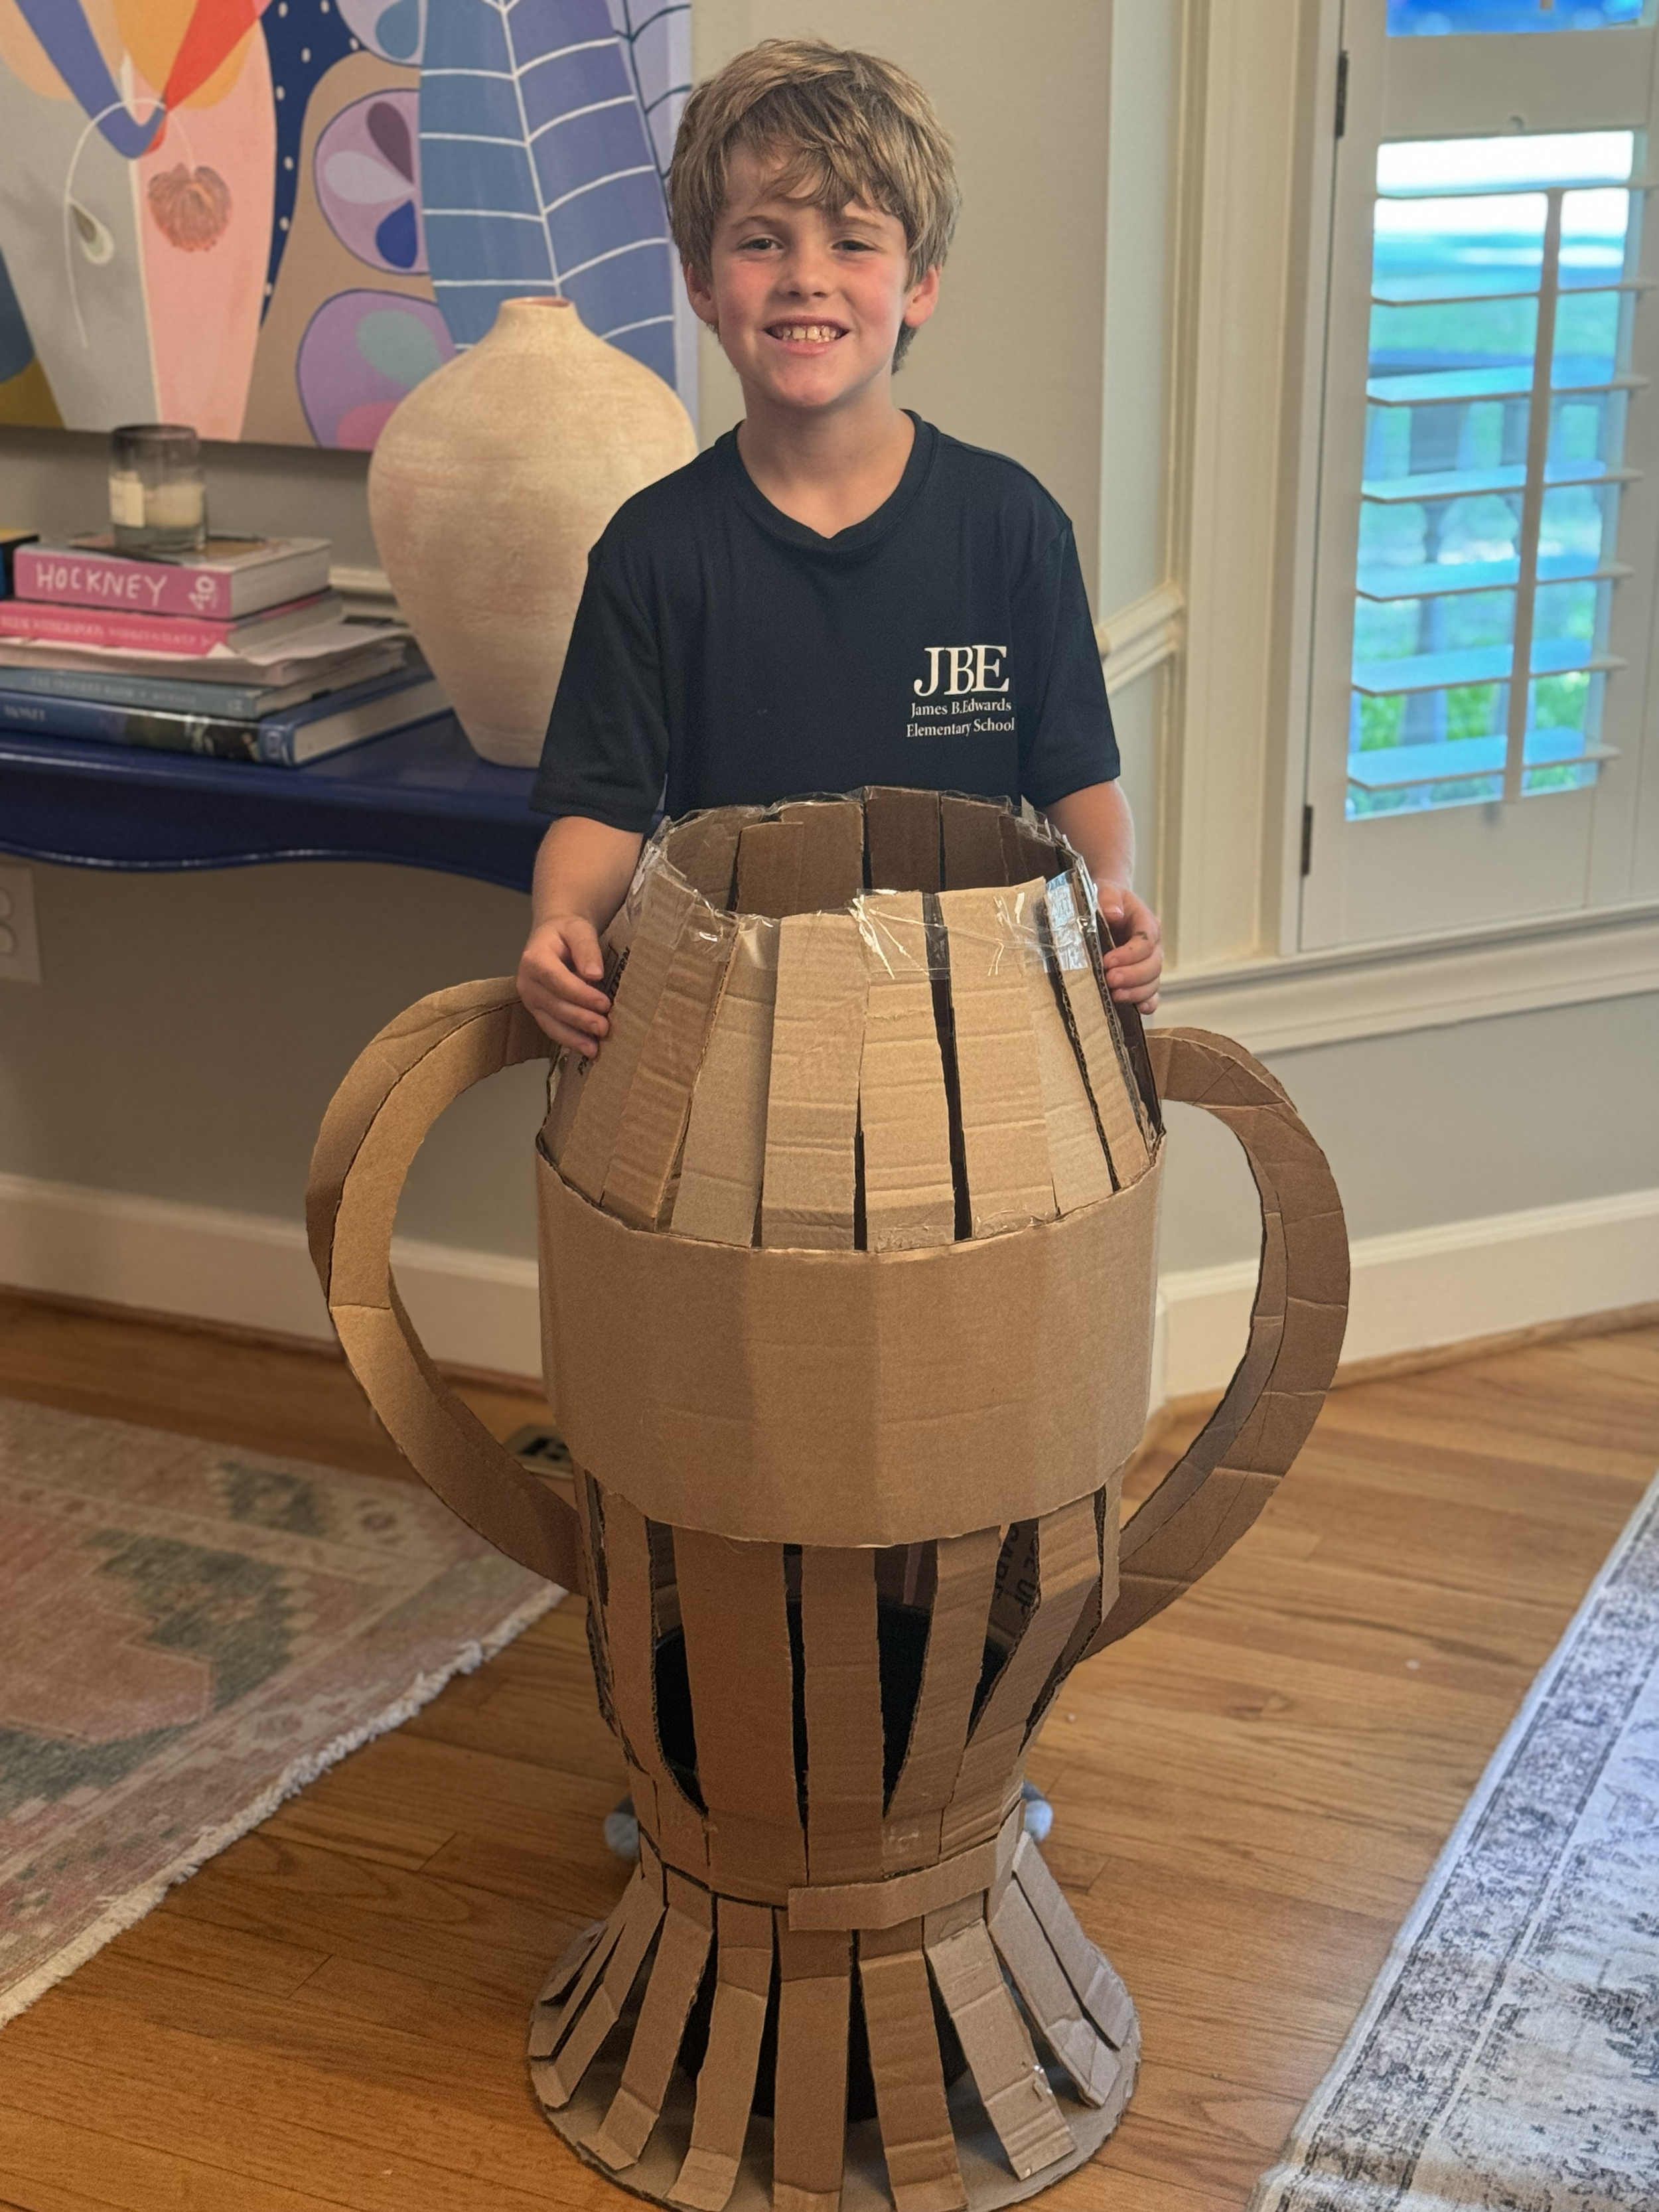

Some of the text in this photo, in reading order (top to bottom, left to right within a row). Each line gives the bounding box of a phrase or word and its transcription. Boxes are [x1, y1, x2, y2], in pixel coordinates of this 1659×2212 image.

[36, 561, 168, 607] HOCKNEY
[914, 644, 1009, 697] JBE
[911, 702, 948, 718] James
[906, 717, 1015, 737] Elementary School
